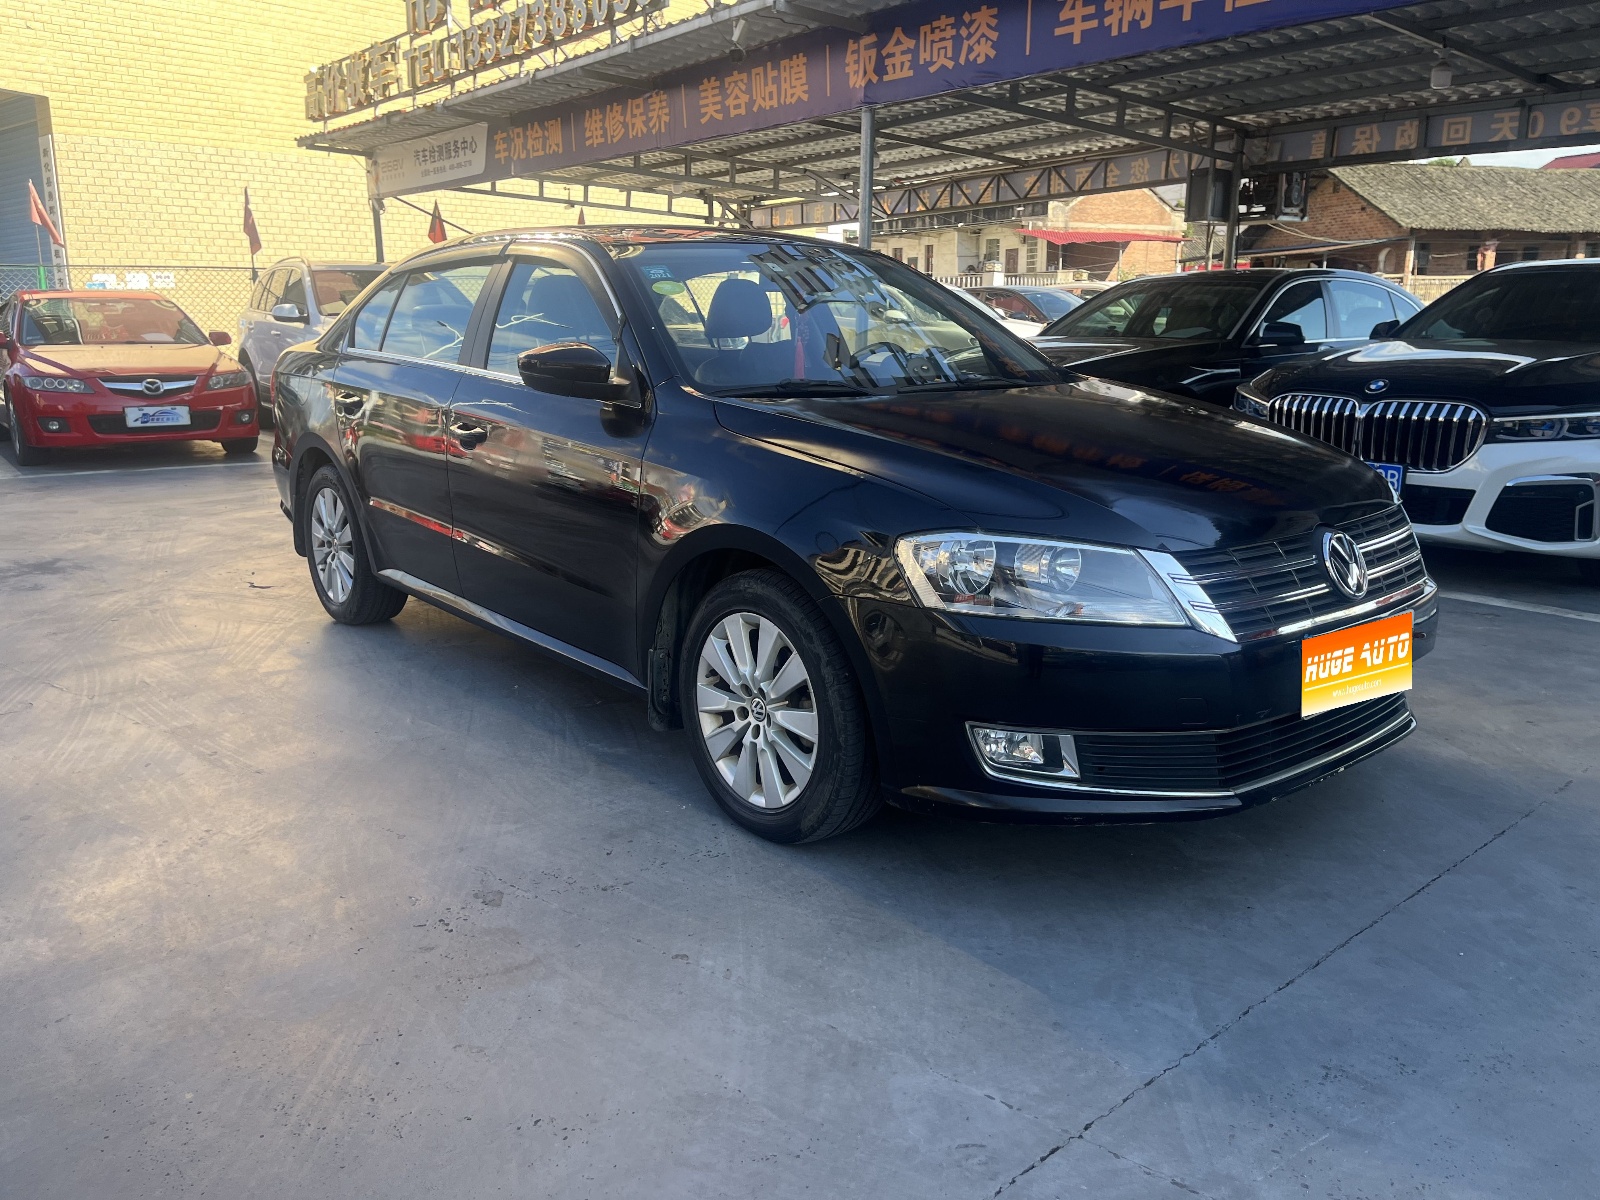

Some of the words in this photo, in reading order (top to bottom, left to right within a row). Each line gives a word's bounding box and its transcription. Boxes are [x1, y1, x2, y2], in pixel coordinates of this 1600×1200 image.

[493, 117, 563, 165] 车况检测
[584, 91, 670, 148] 维修保养
[698, 52, 809, 124] 美容贴膜
[845, 5, 999, 88] 钣金喷漆
[413, 136, 478, 167] 汽车检测服务中心
